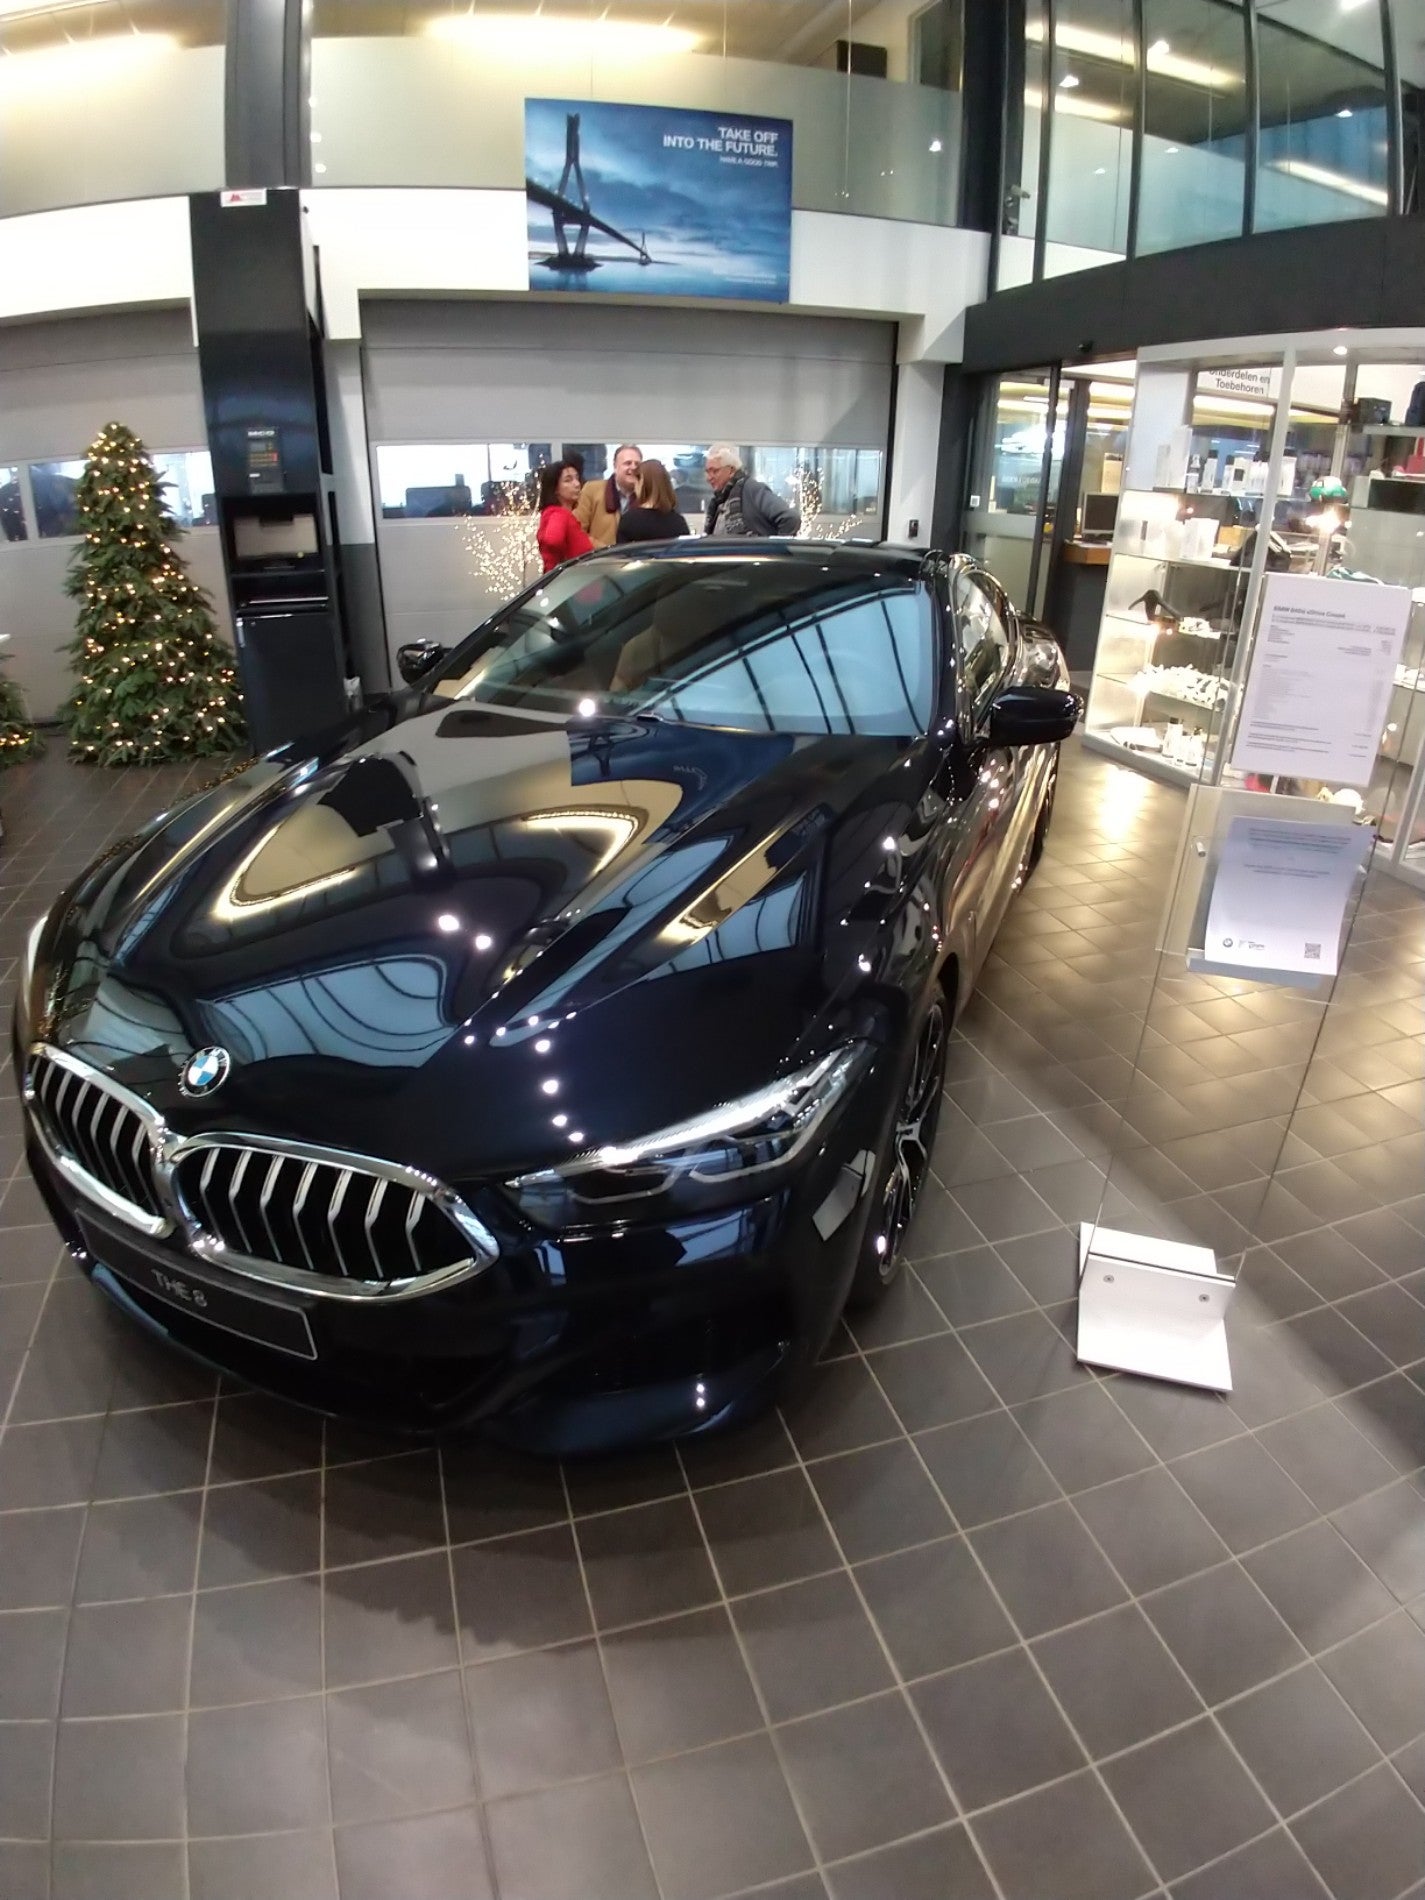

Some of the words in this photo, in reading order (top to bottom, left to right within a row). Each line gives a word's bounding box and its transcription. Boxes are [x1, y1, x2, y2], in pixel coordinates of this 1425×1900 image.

[718, 127, 752, 141] TAKE
[753, 131, 779, 143] OFF
[663, 134, 695, 150] INTO
[697, 138, 723, 152] THE
[725, 141, 779, 157] FUTURE.
[1215, 378, 1264, 394] Toebehoren
[1260, 376, 1271, 384] en
[150, 1269, 192, 1301] THE
[192, 1289, 208, 1307] 8
